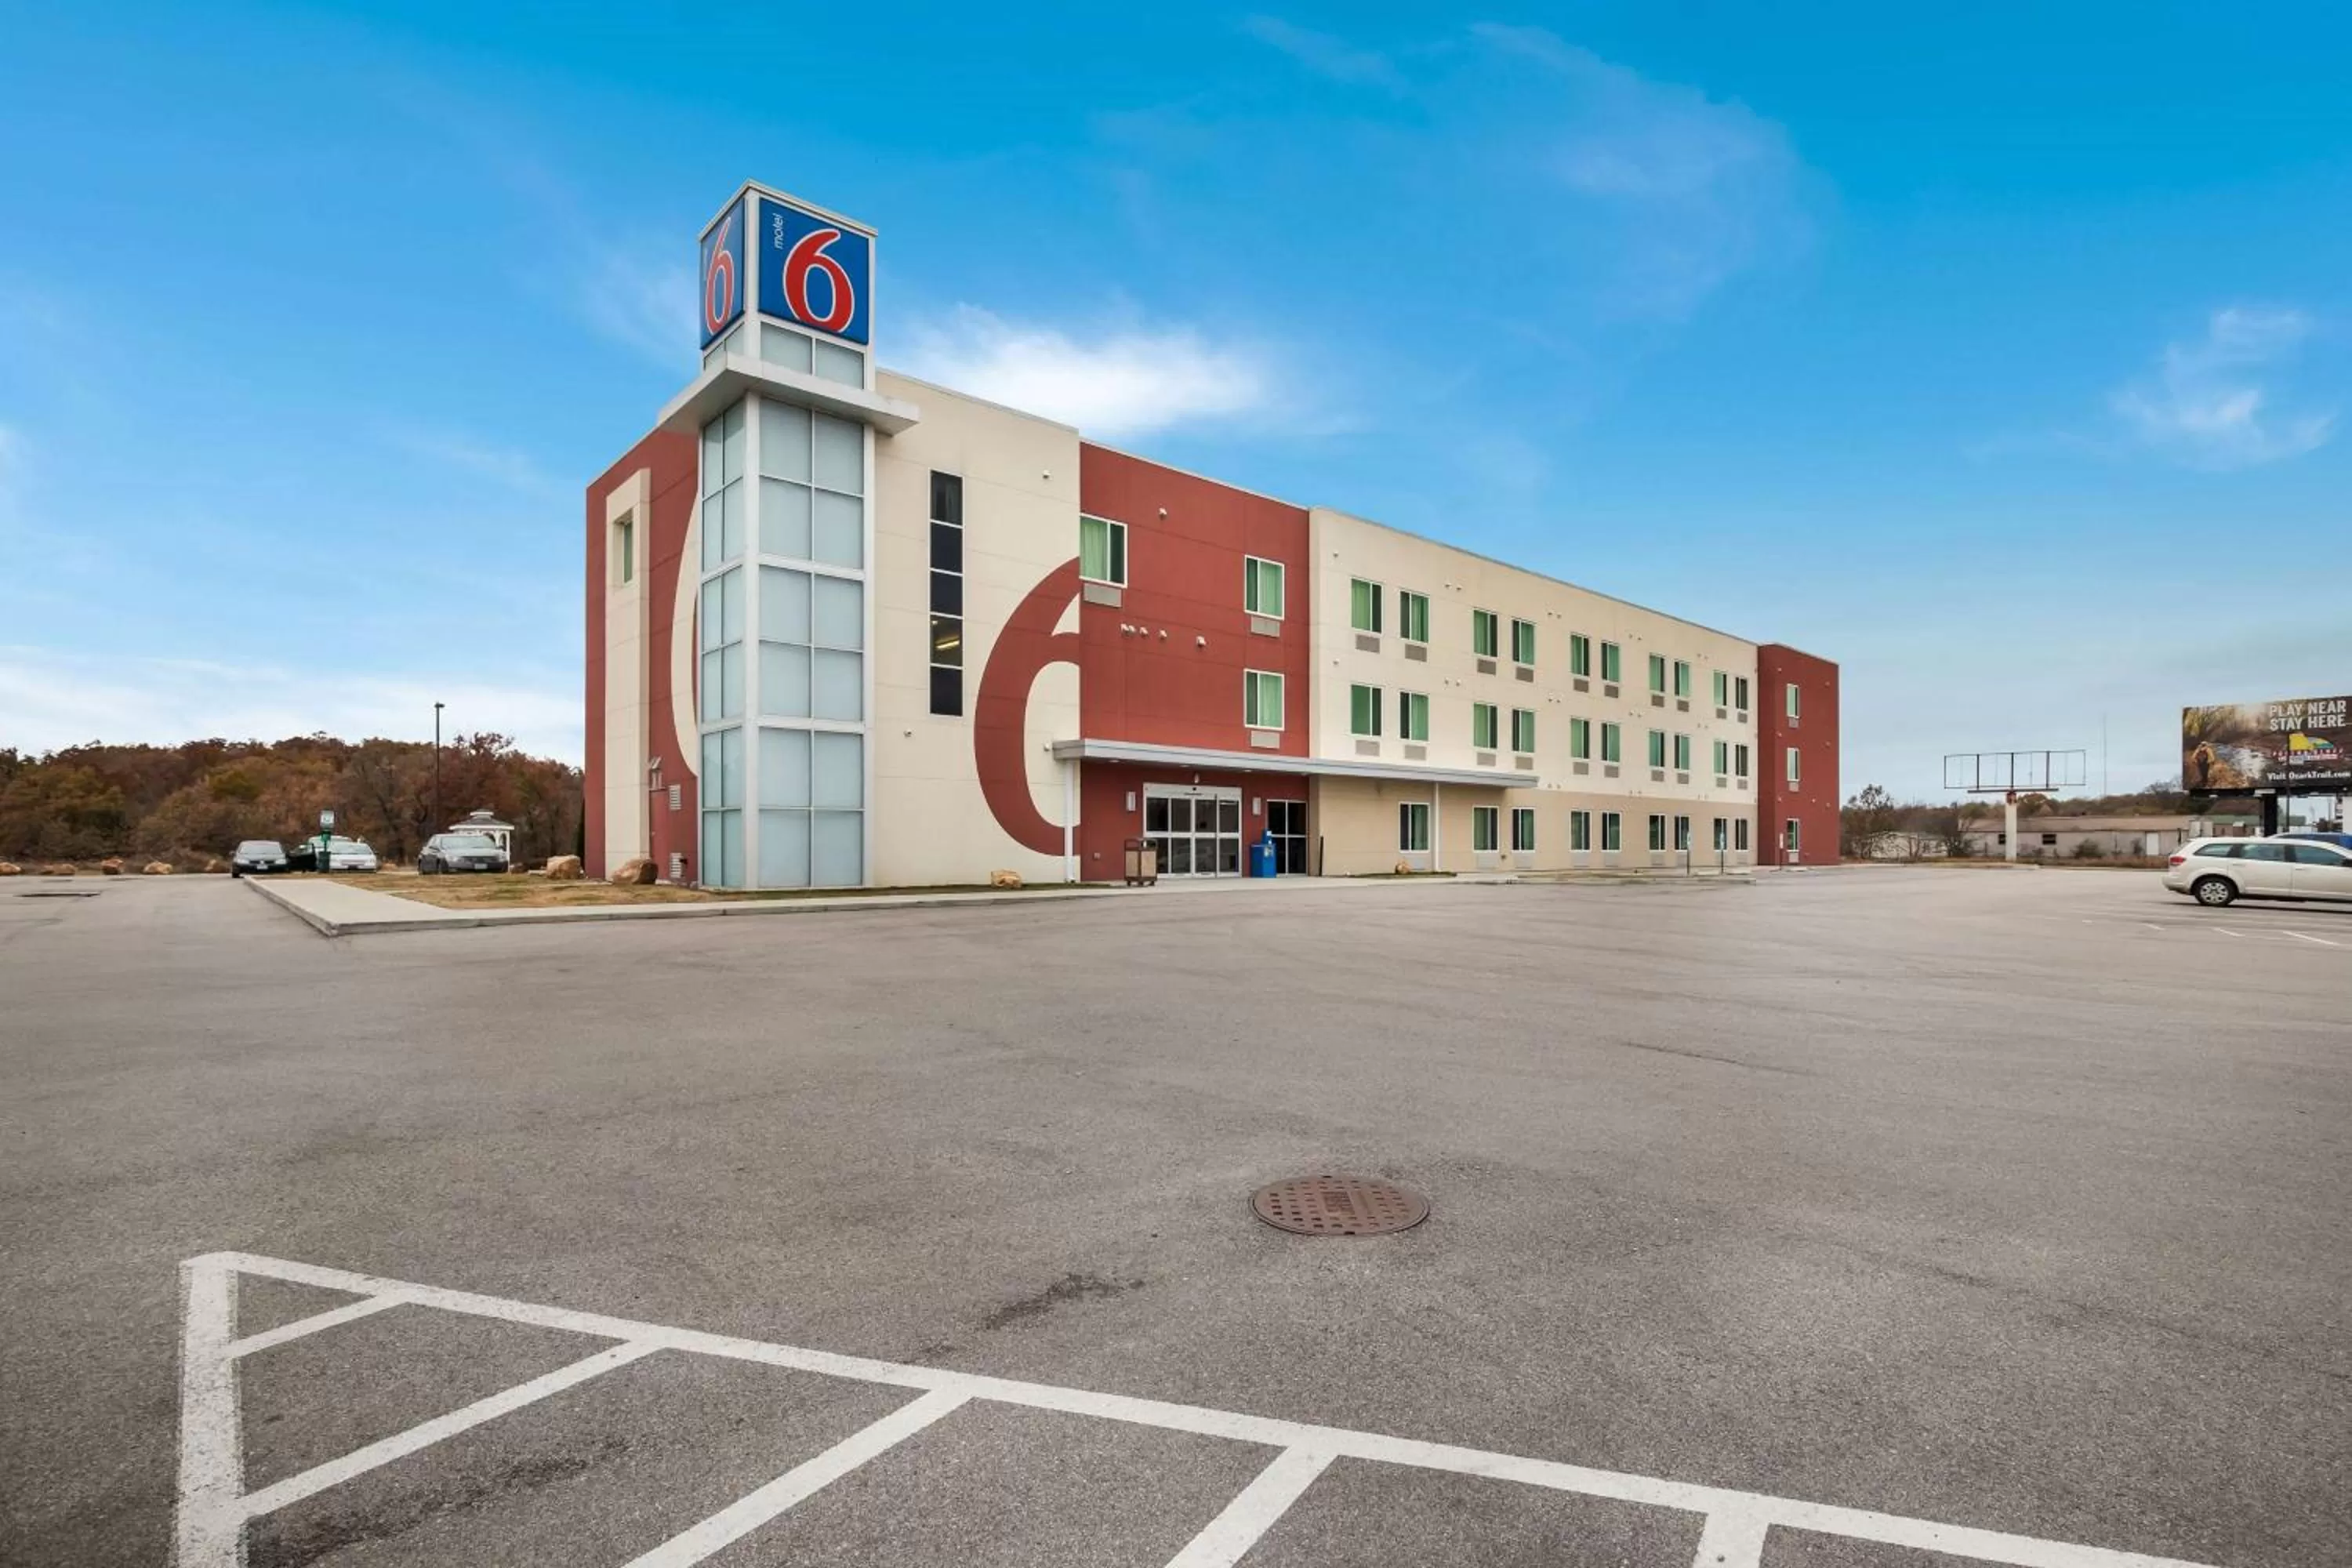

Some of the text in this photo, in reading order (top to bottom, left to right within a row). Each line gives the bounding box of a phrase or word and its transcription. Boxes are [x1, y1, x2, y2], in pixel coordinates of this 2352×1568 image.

[773, 212, 784, 250] motel
[706, 216, 735, 336] 6
[783, 228, 855, 333] 6
[2270, 700, 2347, 717] PLAY NEAR
[2270, 714, 2347, 731] STAY HERE
